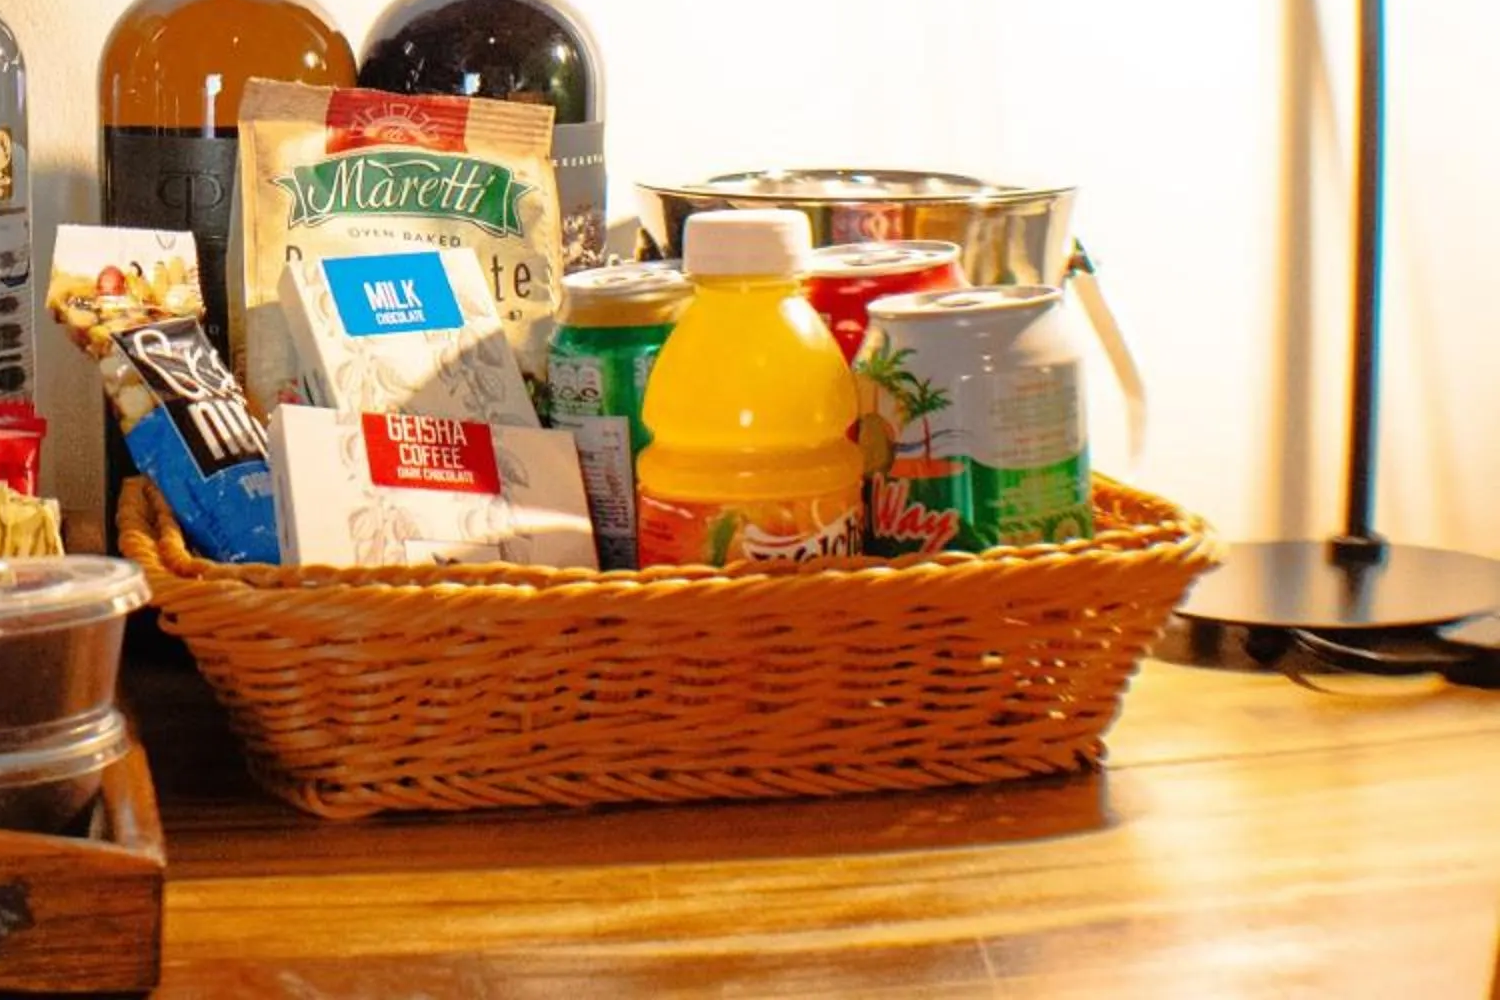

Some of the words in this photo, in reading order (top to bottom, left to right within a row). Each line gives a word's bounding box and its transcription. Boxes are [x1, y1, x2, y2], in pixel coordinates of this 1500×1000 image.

[348, 227, 395, 238] OVEN
[403, 232, 461, 248] BAKED
[364, 279, 423, 311] MILK
[375, 310, 427, 325] CHOCOLATE
[387, 412, 468, 447] GEISHA
[399, 442, 465, 469] COFFEE
